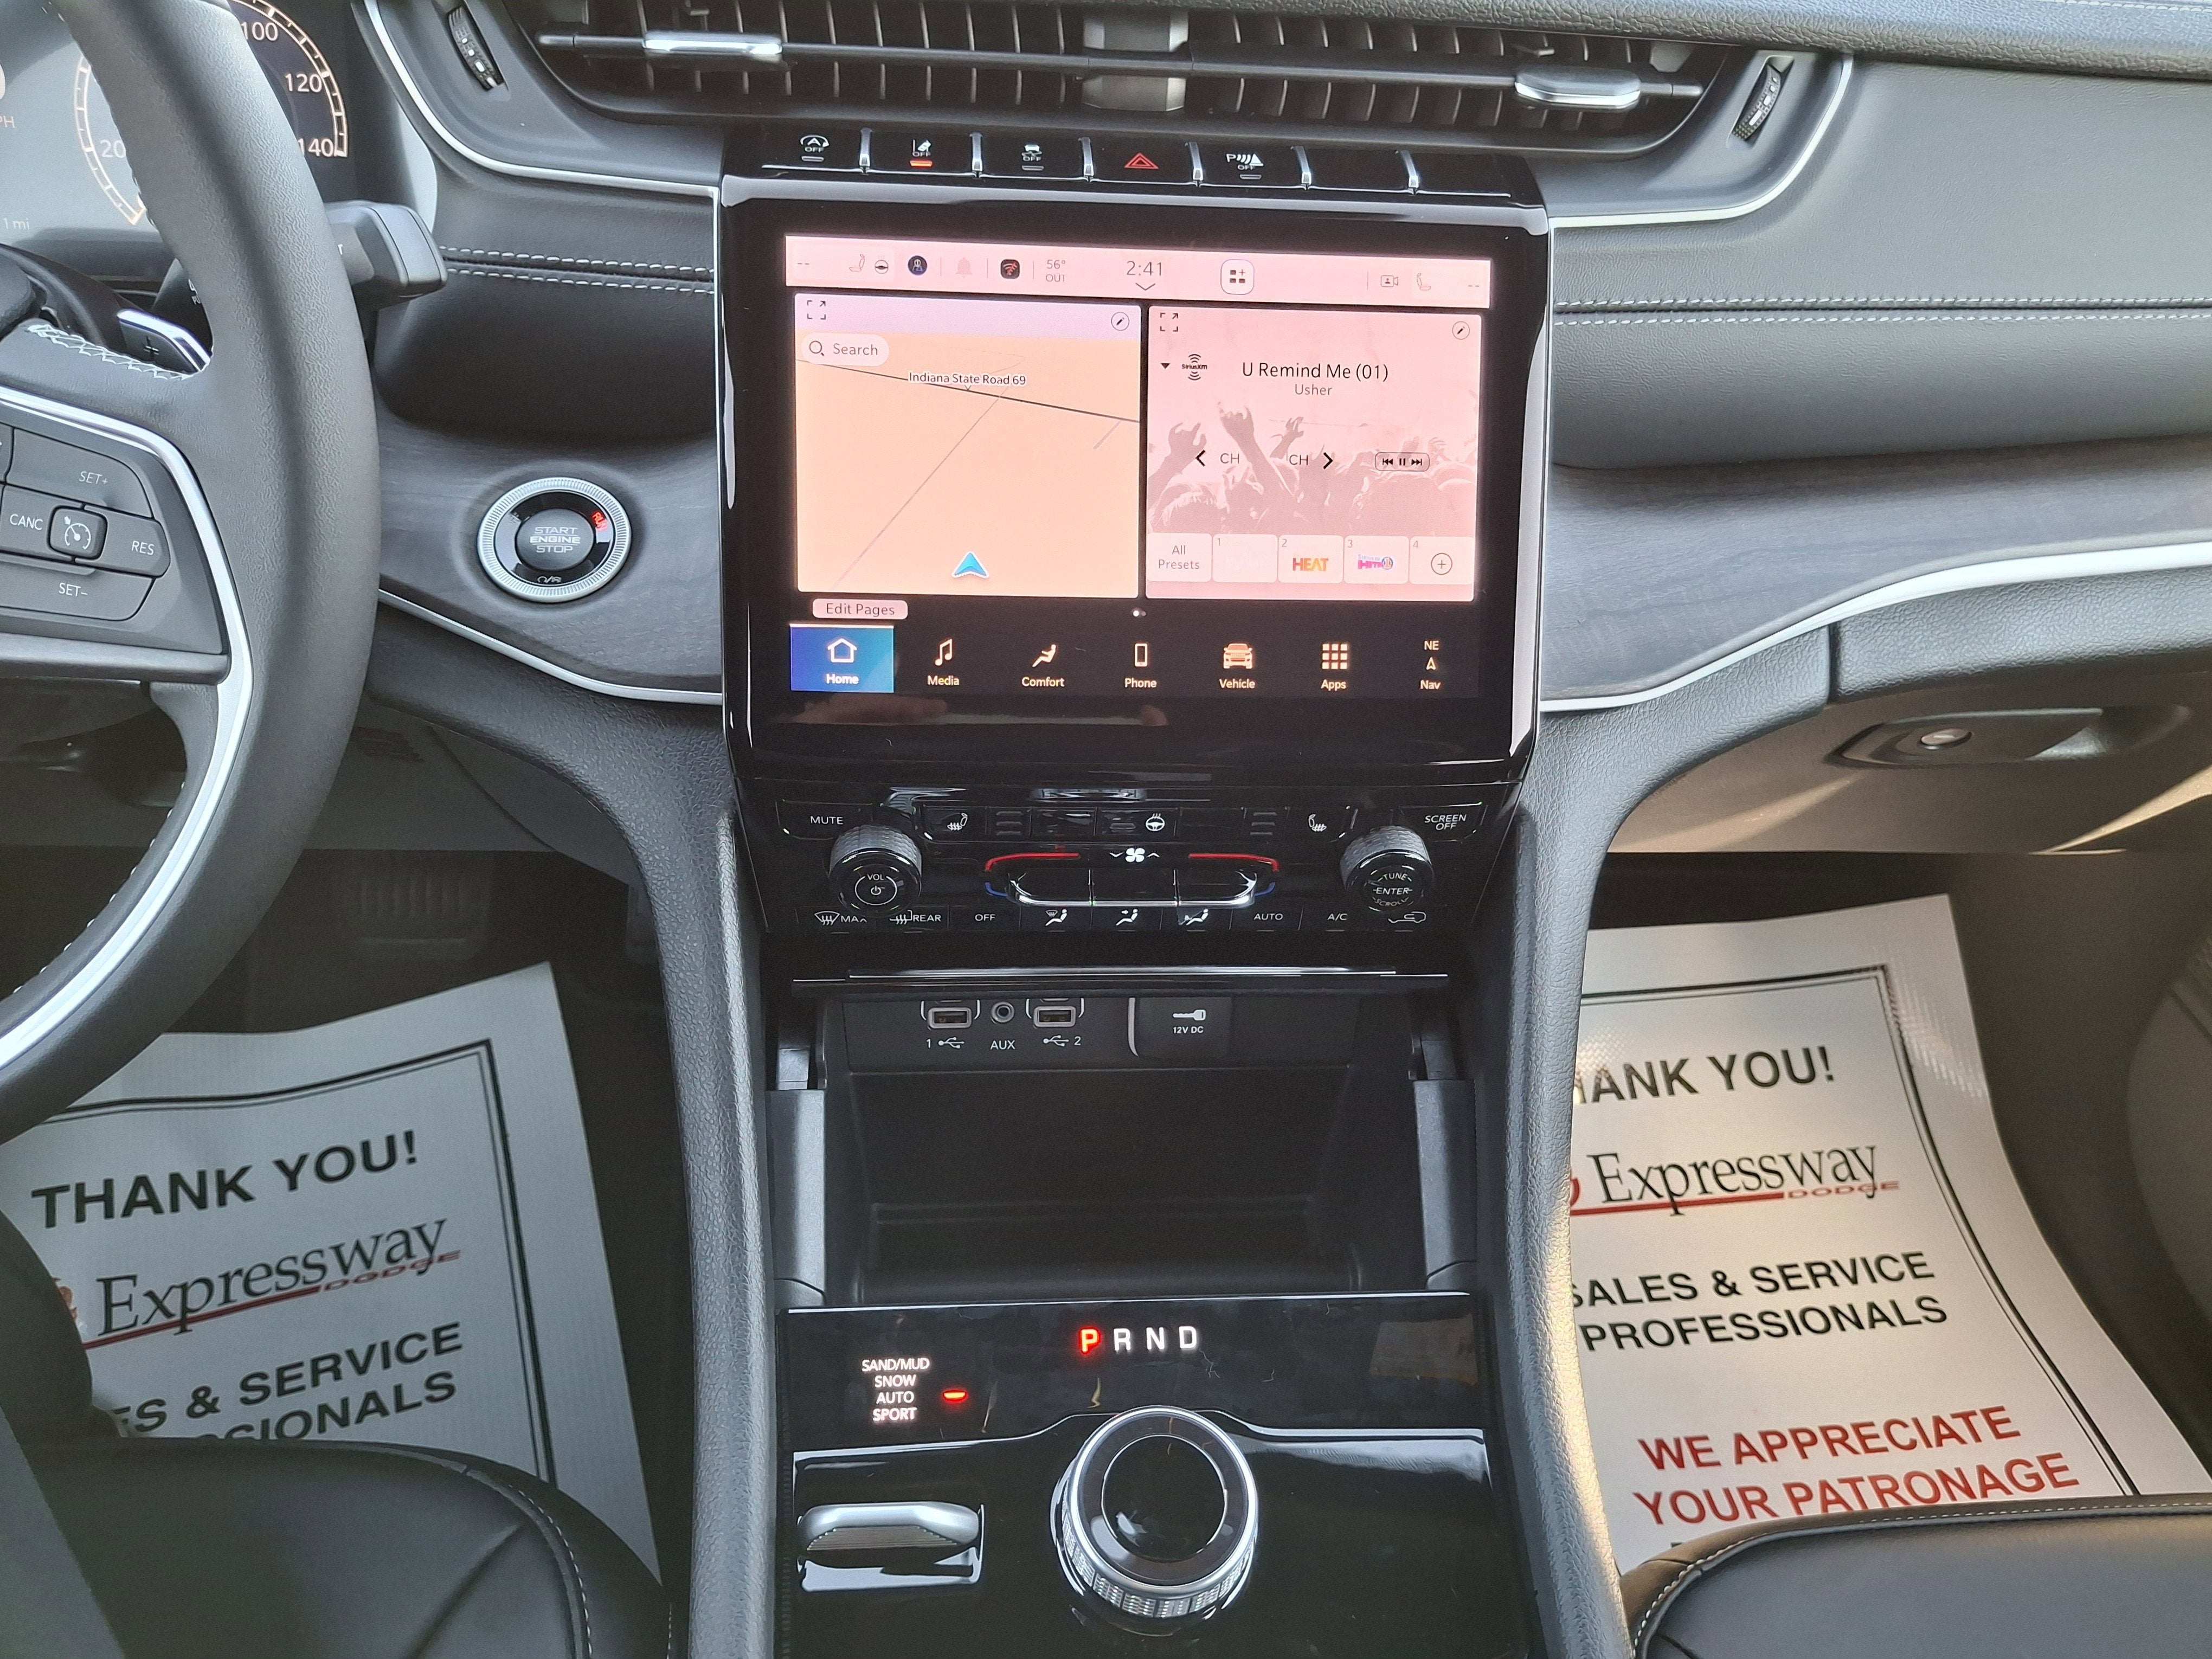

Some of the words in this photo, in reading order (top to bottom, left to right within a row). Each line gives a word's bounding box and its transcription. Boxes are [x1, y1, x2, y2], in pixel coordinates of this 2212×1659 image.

[241, 22, 279, 41] 100
[285, 73, 323, 92] 120
[101, 140, 126, 158] 20
[298, 138, 334, 157] 140
[1046, 259, 1066, 270] 56°
[1127, 261, 1163, 276] 2:41
[1045, 274, 1066, 283] OUT
[833, 342, 878, 356] Search
[909, 372, 950, 384] Indiana
[952, 373, 980, 384] State
[982, 374, 1009, 385] Road
[1012, 375, 1026, 385] 69
[1243, 363, 1252, 377] U
[1259, 363, 1321, 378] Remind
[1327, 365, 1351, 379] Me
[1355, 363, 1388, 383] (01)
[1295, 383, 1333, 396] Usher
[1220, 453, 1240, 465] CH
[1289, 454, 1309, 466] CH
[79, 471, 108, 485] SET+
[10, 514, 43, 531] CANC
[535, 526, 577, 535] START
[530, 536, 581, 544] ENGINE
[1281, 539, 1288, 548] 2
[1348, 539, 1353, 548] 3
[1413, 540, 1419, 549] 4
[132, 541, 155, 555] RES
[536, 545, 573, 553] STOP
[1172, 544, 1186, 556] All
[1158, 558, 1200, 571] Presets
[1292, 557, 1329, 571] HEAT
[826, 603, 851, 615] Edit
[856, 604, 895, 617] Pages
[1424, 640, 1439, 650] NE
[826, 674, 859, 684] Home
[927, 675, 960, 686] Media
[1021, 676, 1065, 687] Comfort
[1124, 678, 1157, 689] Phone
[1219, 679, 1256, 689] Vehicle
[1321, 679, 1346, 691] Apps
[1420, 679, 1441, 690] Nav
[810, 815, 844, 825] MUTE
[1424, 814, 1467, 824] SCREEN
[1435, 822, 1457, 831] OFF
[1382, 872, 1408, 881] TUNE
[1375, 887, 1410, 895] ENTER
[1374, 898, 1406, 907] SCROLL
[1254, 912, 1283, 921] AUTO
[1327, 912, 1348, 921] A/C
[1191, 1025, 1204, 1034] DC
[926, 1038, 932, 1048] 1
[990, 1040, 1015, 1050] AUX
[1073, 1036, 1081, 1046] 2
[1574, 1059, 1698, 1103] ANK
[1706, 1046, 1834, 1092] YOU!
[31, 1165, 256, 1229] THANK
[272, 1130, 418, 1191] YOU!
[1587, 1145, 1877, 1218] Expressway
[1785, 1180, 1900, 1199] DODGE
[323, 1250, 461, 1291] DODGE
[1713, 1270, 1740, 1297] &
[1750, 1251, 1935, 1294] SERVICE
[97, 1219, 448, 1338] Expressway
[1580, 1296, 1947, 1352] PROFESSIONALS
[1081, 1328, 1099, 1353] P
[1114, 1328, 1131, 1352] R
[1147, 1327, 1165, 1351] N
[1179, 1326, 1198, 1349] D
[185, 1385, 222, 1420] &
[239, 1322, 462, 1406] SERVICE
[861, 1358, 930, 1372] SAND/MUD
[874, 1375, 917, 1387] SNOW
[876, 1392, 915, 1404] AUTO
[873, 1409, 917, 1422] SPORT
[1637, 1434, 1721, 1471] WE
[1734, 1404, 2022, 1465] APPRECIATE
[1632, 1483, 1778, 1526] YOUR
[1782, 1452, 2080, 1516] PATRONAGE
